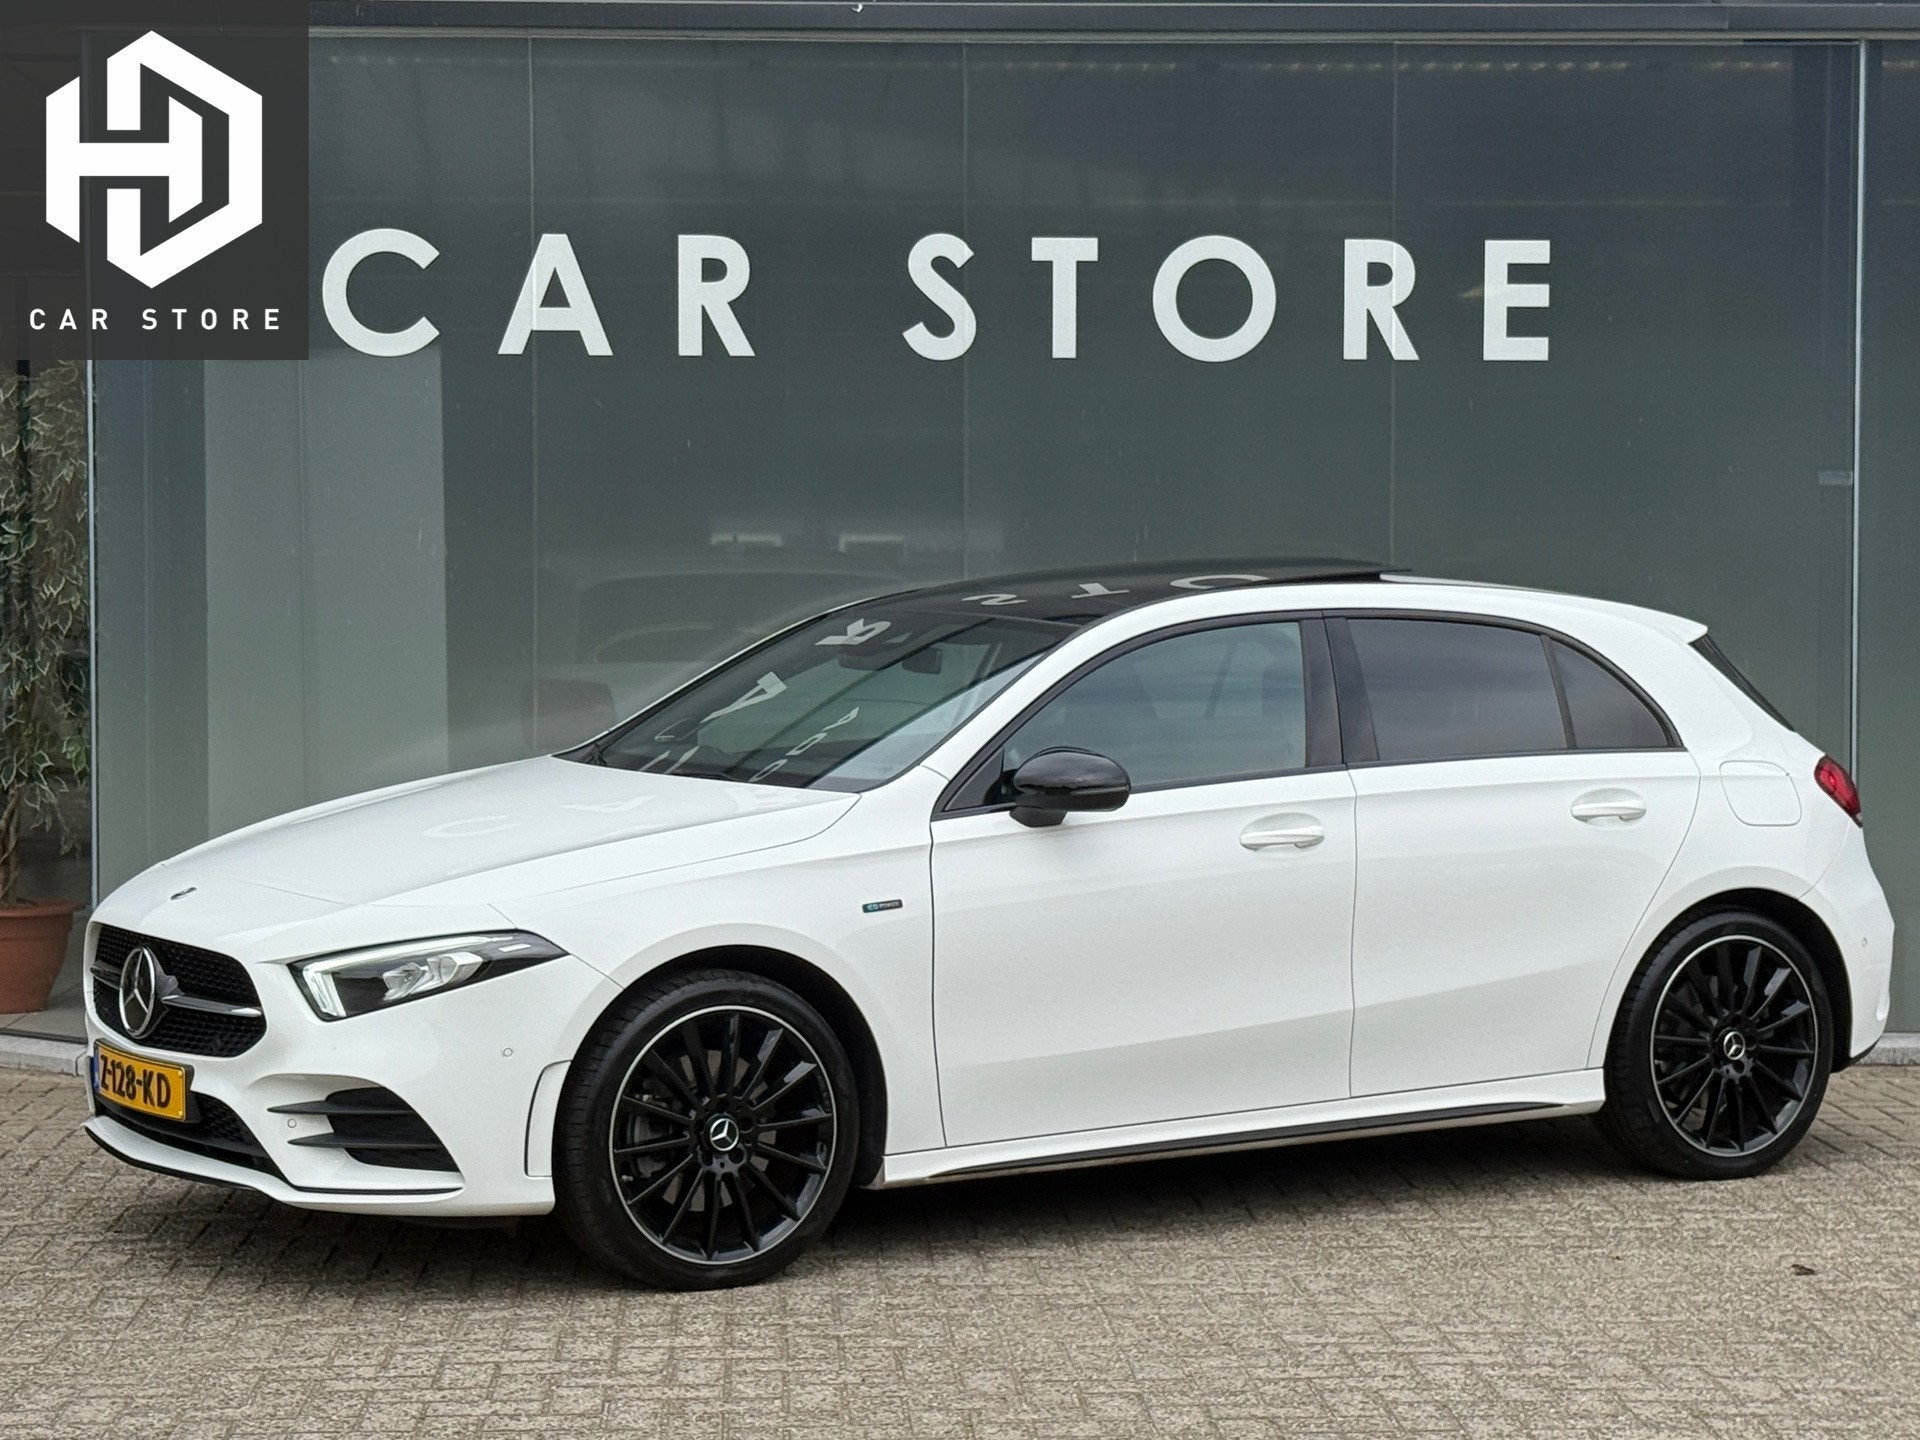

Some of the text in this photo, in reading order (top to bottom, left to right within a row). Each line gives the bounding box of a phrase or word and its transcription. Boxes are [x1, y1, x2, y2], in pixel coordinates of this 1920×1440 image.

[323, 229, 1551, 362] CAR STORE
[100, 1054, 171, 1109] Z-128-KD
